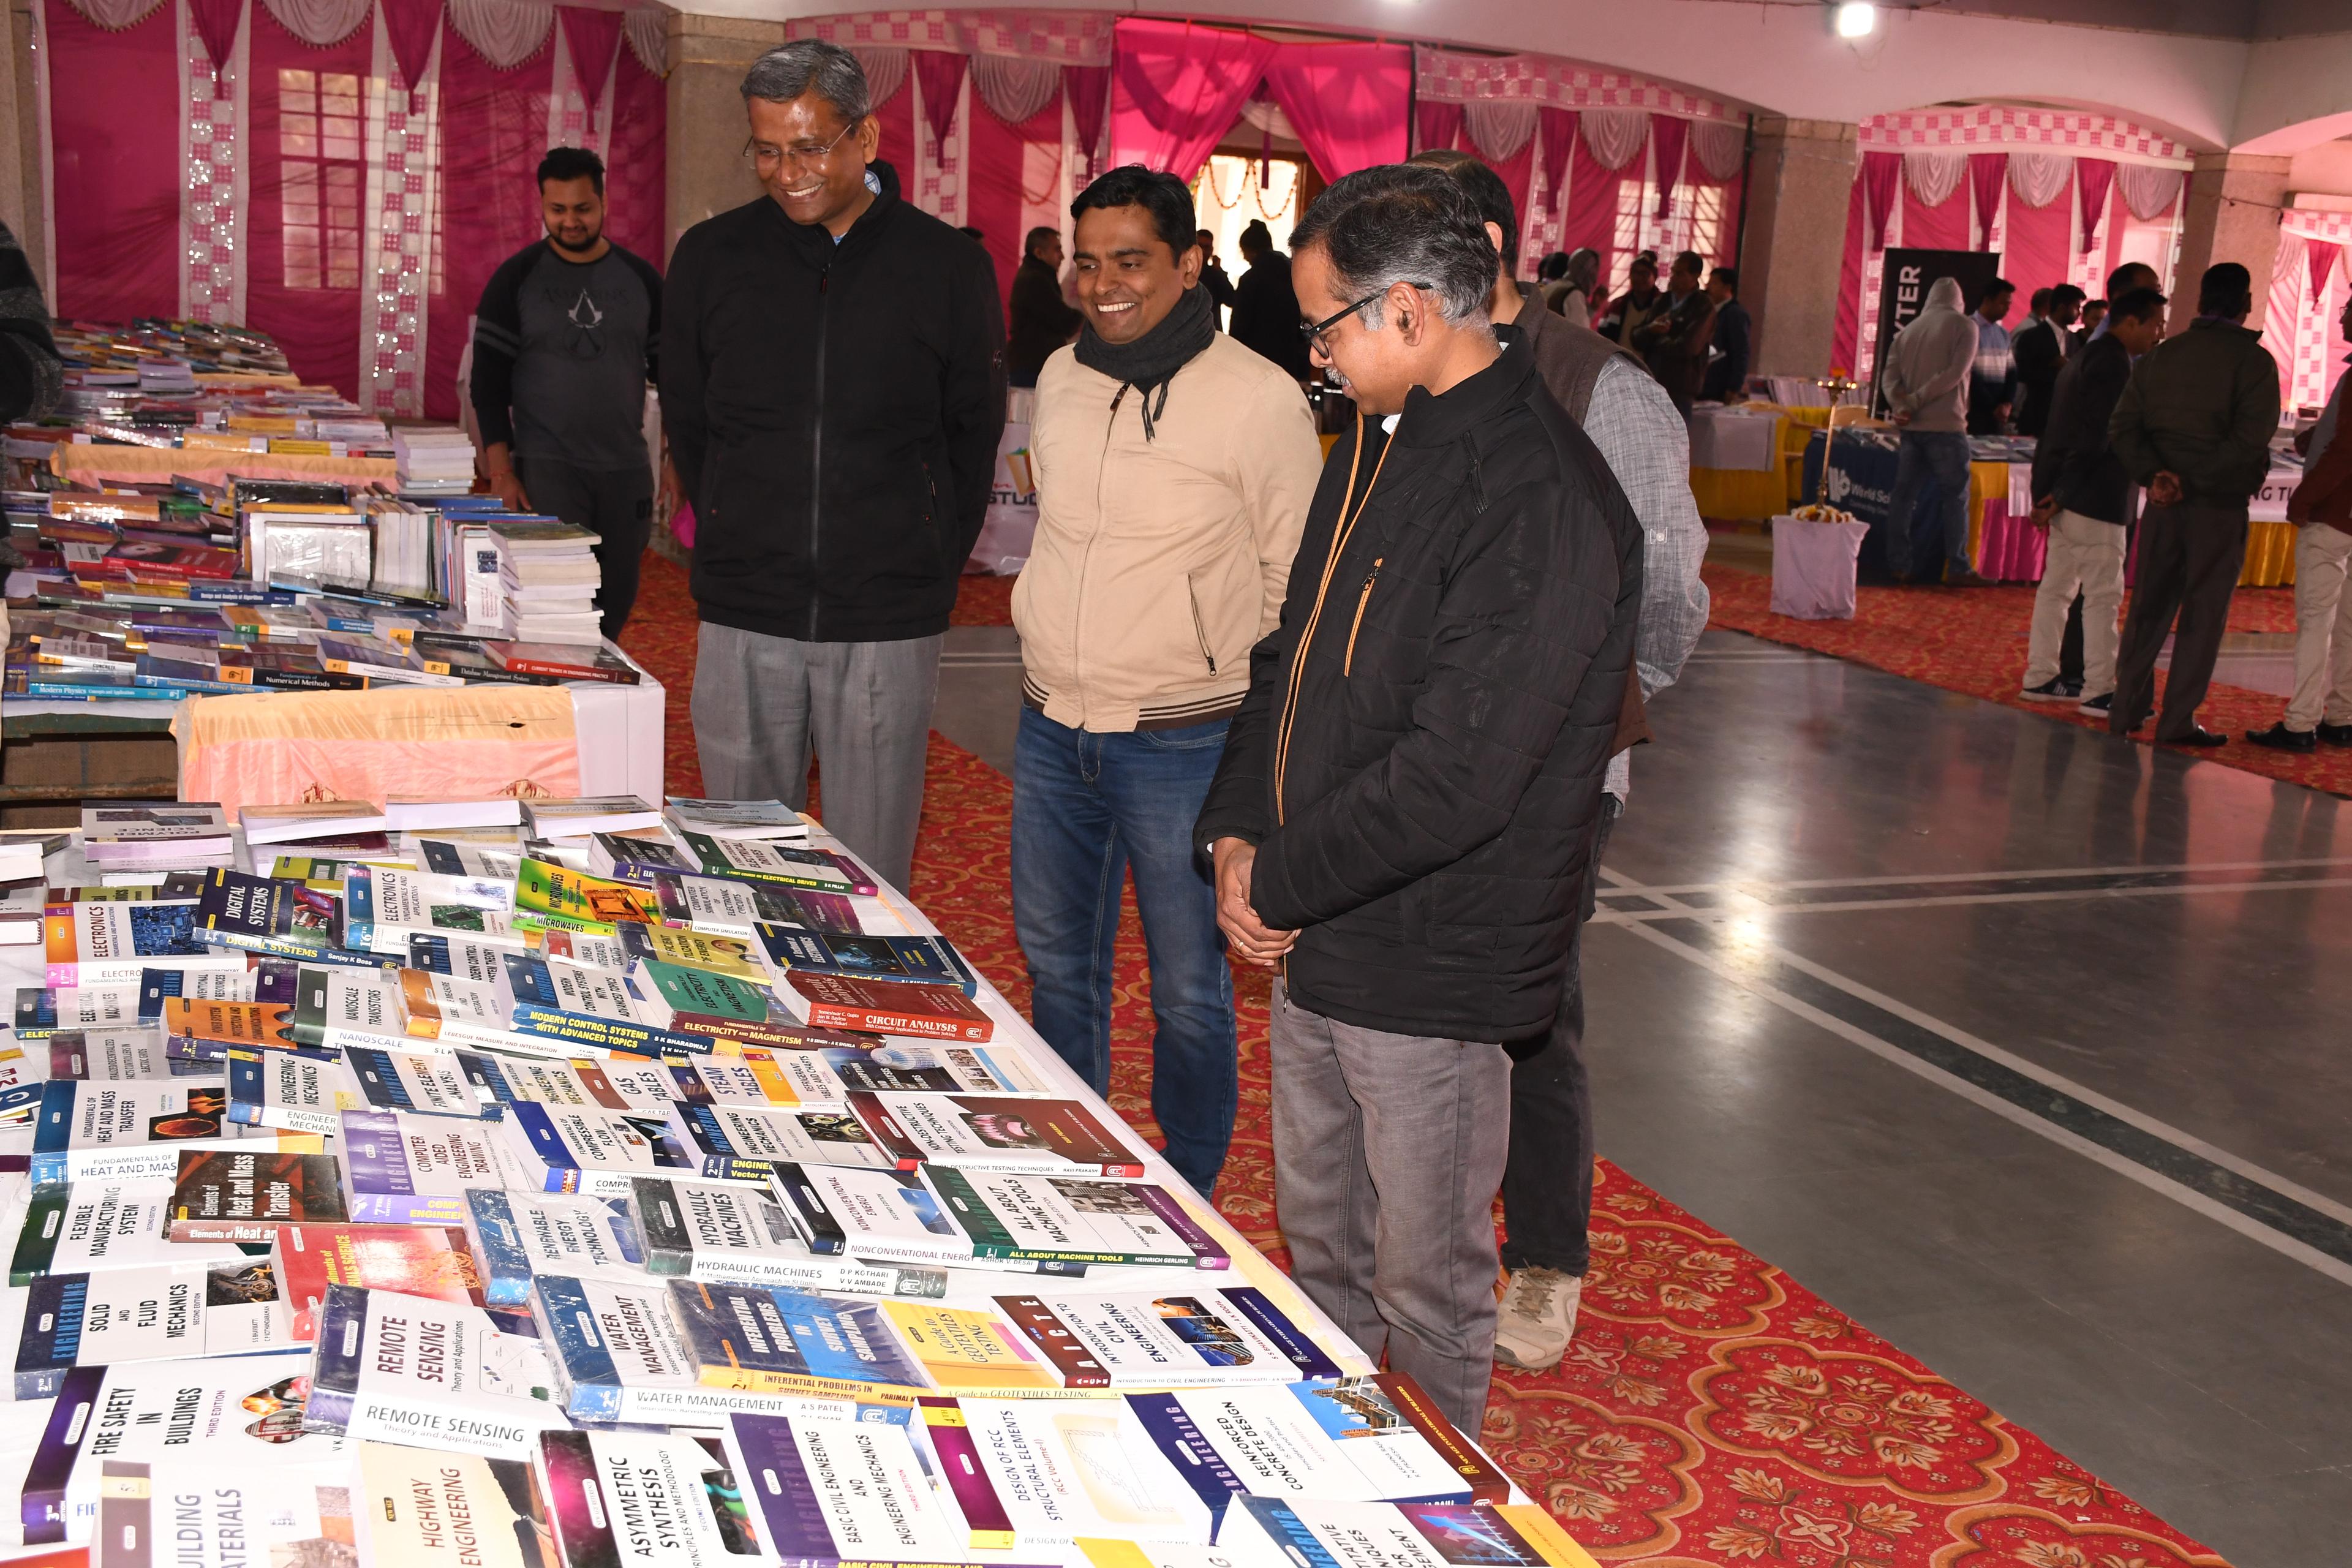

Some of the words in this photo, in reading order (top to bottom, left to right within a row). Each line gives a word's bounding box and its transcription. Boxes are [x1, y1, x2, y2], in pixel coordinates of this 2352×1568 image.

[266, 677, 293, 685] Numerical
[294, 679, 331, 687] Methods
[461, 668, 482, 677] Database
[763, 875, 796, 884] ELECTRICAL
[383, 872, 399, 922] ELECTRONICS
[89, 905, 108, 958] ELECTRONICS
[536, 916, 584, 932] MICROWAVES
[720, 927, 748, 936] SIMULATION
[225, 935, 266, 950] DIGITAL
[270, 943, 318, 958] SYSTEMS
[328, 953, 349, 963] Sanjay
[345, 986, 359, 1021] NANOSCALE
[368, 989, 382, 1026] TRANSISTORS
[530, 1011, 565, 1025] MODERN
[568, 1019, 606, 1031] CONTROL
[610, 1026, 649, 1039] SYSTEMS
[537, 1023, 558, 1035] WITH
[561, 1027, 606, 1042] ADVANCED
[608, 1036, 638, 1049] TOPICS
[684, 1023, 737, 1037] ELECTRICITY
[749, 1032, 802, 1045] MAGNETISM
[725, 1022, 756, 1030] FUNDAMENTALS
[866, 1015, 905, 1028] CIRCUIT
[907, 1019, 957, 1033] ANALYSIS
[444, 1031, 473, 1039] LEBESGUE
[475, 1035, 502, 1044] MEASURE
[519, 1042, 557, 1053] INTEGRATION
[667, 1038, 707, 1050] BHARADWAJ
[281, 1060, 297, 1104] ENGINEERING
[304, 1065, 318, 1106] MECHANICS
[410, 1057, 436, 1087] ELEMENT
[436, 1071, 466, 1100] ANALYSIS
[616, 1077, 643, 1095] GAS
[636, 1072, 671, 1101] TABLES
[704, 1067, 732, 1096] STEAM
[732, 1068, 763, 1097] TABLES
[102, 1091, 116, 1109] MASS
[427, 1087, 448, 1107] FINITE
[83, 1104, 94, 1137] FUNDAMENTALS
[99, 1110, 114, 1125] AND
[119, 1100, 135, 1132] TRANSFER
[896, 1106, 944, 1151] NON-DESTRUCTIVE
[913, 1102, 946, 1134] TECHNIQUES
[97, 1126, 111, 1143] HEAT
[568, 1114, 606, 1161] COMPRESSIBLE
[595, 1129, 614, 1146] FLOW
[727, 1113, 763, 1155] ENGINEERING
[746, 1118, 777, 1153] MECHANICS
[943, 1133, 968, 1153] TESTING
[228, 1155, 254, 1177] Mass
[411, 1136, 432, 1172] COMPUTER
[432, 1144, 448, 1165] AIDED
[448, 1134, 473, 1179] ENGINEERING
[468, 1141, 489, 1174] DRAWING
[228, 1178, 254, 1198] and
[264, 1182, 290, 1217] Transfer
[200, 1193, 219, 1216] Elements
[227, 1199, 254, 1217] Heat
[70, 1204, 94, 1240] FLEXIBLE
[89, 1187, 121, 1256] MANUFACTURING
[118, 1204, 140, 1235] SYSTEM
[851, 1245, 939, 1258] NONCONVENTIONAL
[943, 1252, 974, 1261] ENERGY
[697, 1261, 761, 1274] HYDRAULIC
[764, 1266, 823, 1278] MACHINES
[855, 1269, 889, 1278] KOTHARI
[89, 1304, 110, 1332] SOLID
[119, 1310, 130, 1321] AND
[138, 1300, 158, 1327] FLUID
[167, 1284, 187, 1338] MECHANICS
[1056, 1303, 1076, 1315] TO
[377, 1316, 407, 1374] REMOTE
[455, 1321, 464, 1357] Applications
[601, 1313, 626, 1351] WATER
[615, 1295, 665, 1374] MANAGEMENT
[1066, 1314, 1122, 1364] INTRODUCTION
[1095, 1321, 1125, 1344] CIVIL
[1100, 1303, 1168, 1363] ENGINEERING
[417, 1321, 445, 1382] SENSING
[454, 1359, 462, 1372] and
[452, 1372, 462, 1392] Theory
[764, 1375, 815, 1387] INFERENTIAL
[818, 1381, 858, 1392] PROBLEMS
[990, 1389, 1052, 1398] GEOTEXTILES
[1054, 1390, 1091, 1398] TESTING
[101, 1389, 135, 1427] SAFETY
[136, 1412, 163, 1425] IN
[164, 1387, 202, 1444] BUILDINGS
[1221, 1401, 1261, 1436] DESIGN
[91, 1429, 123, 1455] FIRE
[987, 1430, 1006, 1448] RCC
[1001, 1411, 1031, 1460] ELEMENTS
[1216, 1417, 1273, 1477] REINFORCED
[805, 1431, 839, 1489] ENGINEERING
[856, 1434, 886, 1486] MECHANICS
[1000, 1450, 1013, 1463] OF
[1253, 1438, 1304, 1489] CONCRETE
[849, 1479, 869, 1497] AND
[1006, 1466, 1031, 1501] DESIGN
[1023, 1465, 1063, 1521] STRUCTURAL
[412, 1479, 445, 1548] HIGHWAY
[440, 1469, 481, 1566] ENGINEERING
[609, 1457, 654, 1557] ASYMMETRIC
[639, 1468, 680, 1549] SYNTHESIS
[829, 1492, 851, 1515] CIVIL
[880, 1487, 916, 1545] ENGINEERING
[839, 1517, 862, 1544] BASIC
